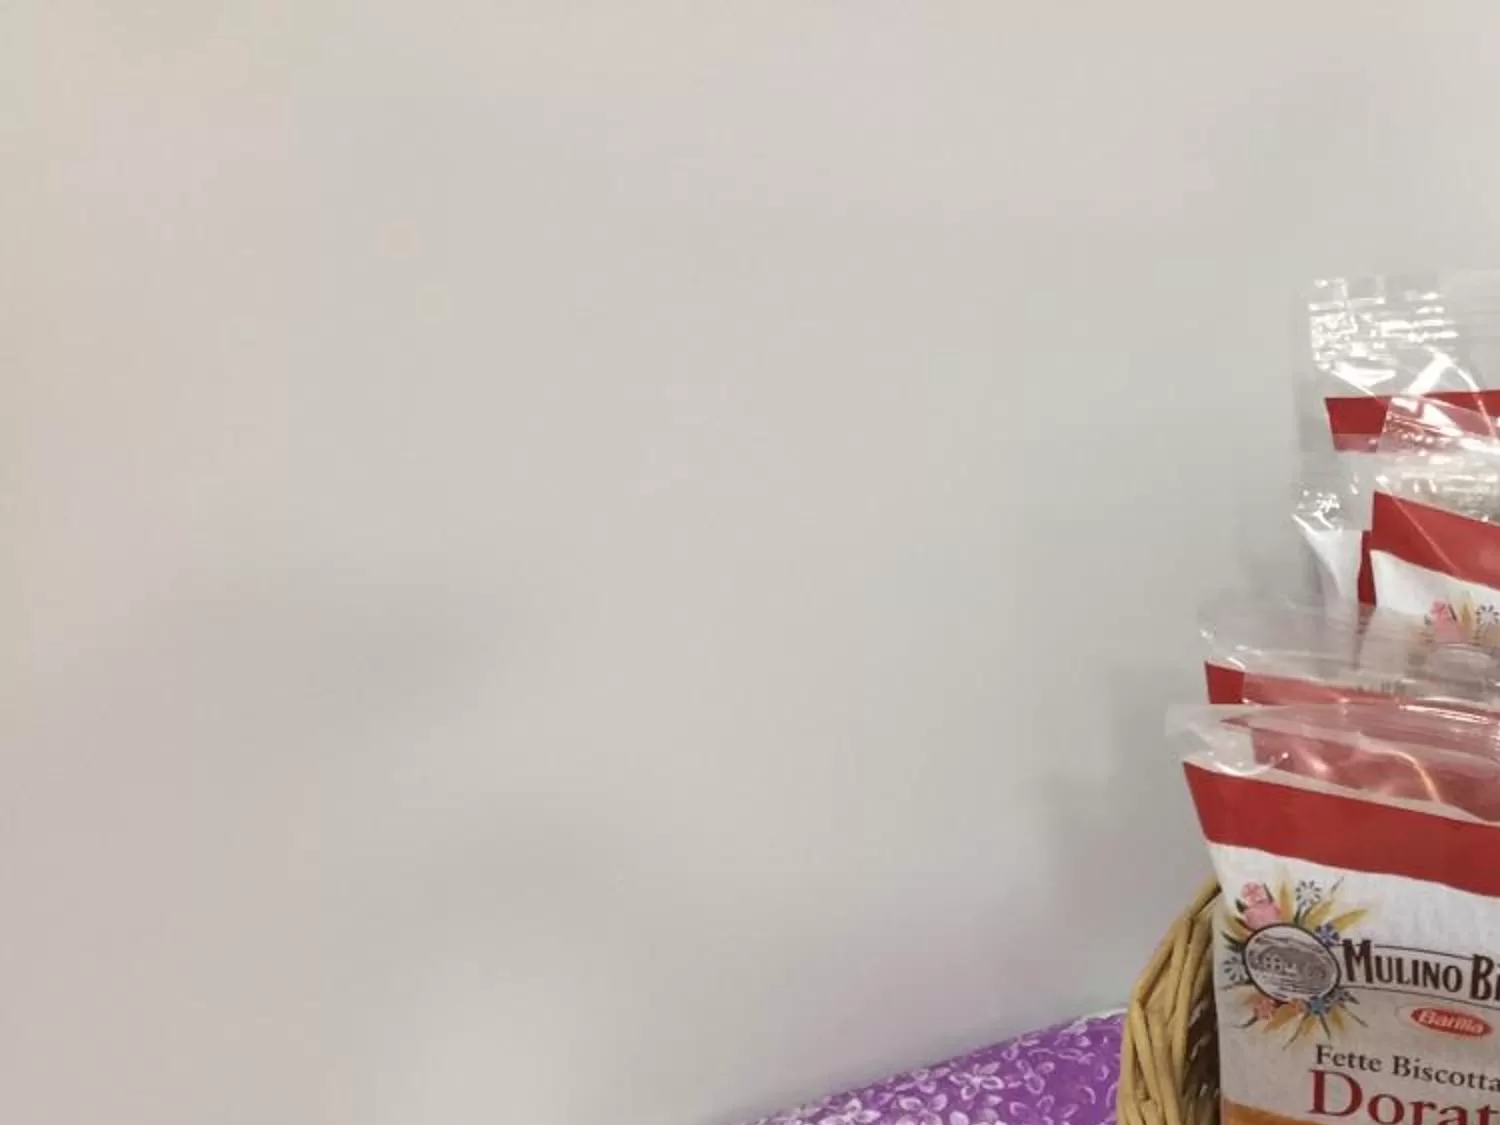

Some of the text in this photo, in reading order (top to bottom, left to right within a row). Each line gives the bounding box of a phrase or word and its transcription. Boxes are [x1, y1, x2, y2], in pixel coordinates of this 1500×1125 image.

[1341, 939, 1462, 992] MULINO
[1417, 1009, 1485, 1034] Barilla
[1315, 1044, 1382, 1073] Fette
